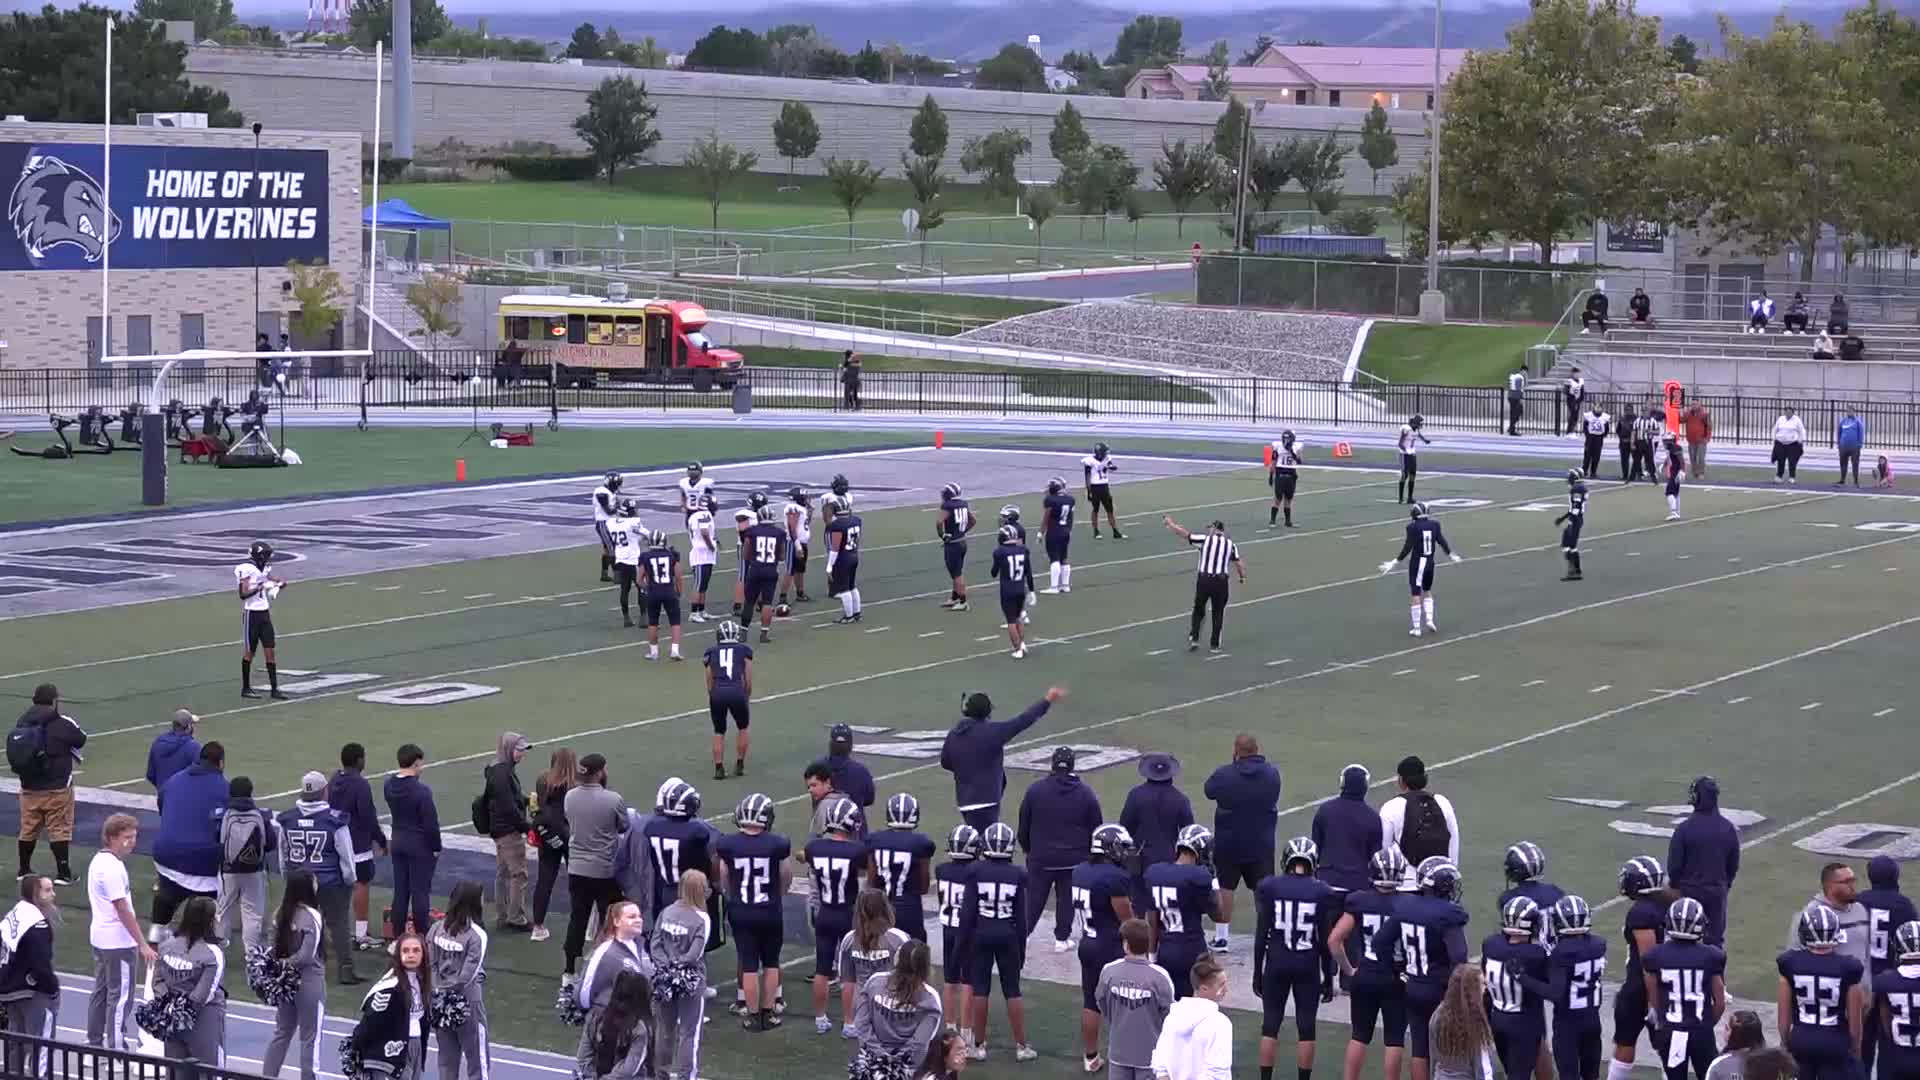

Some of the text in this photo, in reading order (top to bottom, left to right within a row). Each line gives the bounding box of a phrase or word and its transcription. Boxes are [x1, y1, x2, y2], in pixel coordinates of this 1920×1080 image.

[146, 169, 305, 199] HOME OF THE
[132, 206, 317, 240] WOLVERINES
[649, 556, 671, 584] 13
[756, 536, 777, 563] 99
[1007, 554, 1025, 581] 15
[719, 648, 735, 680] 4
[287, 829, 328, 863] 57
[650, 836, 681, 885] 17
[734, 857, 771, 904] 72
[813, 857, 851, 905] 37
[874, 849, 912, 898] 47
[1151, 886, 1184, 934] 16
[1274, 900, 1317, 952] 45
[1661, 968, 1705, 1023] 34
[1793, 975, 1842, 1026] 22
